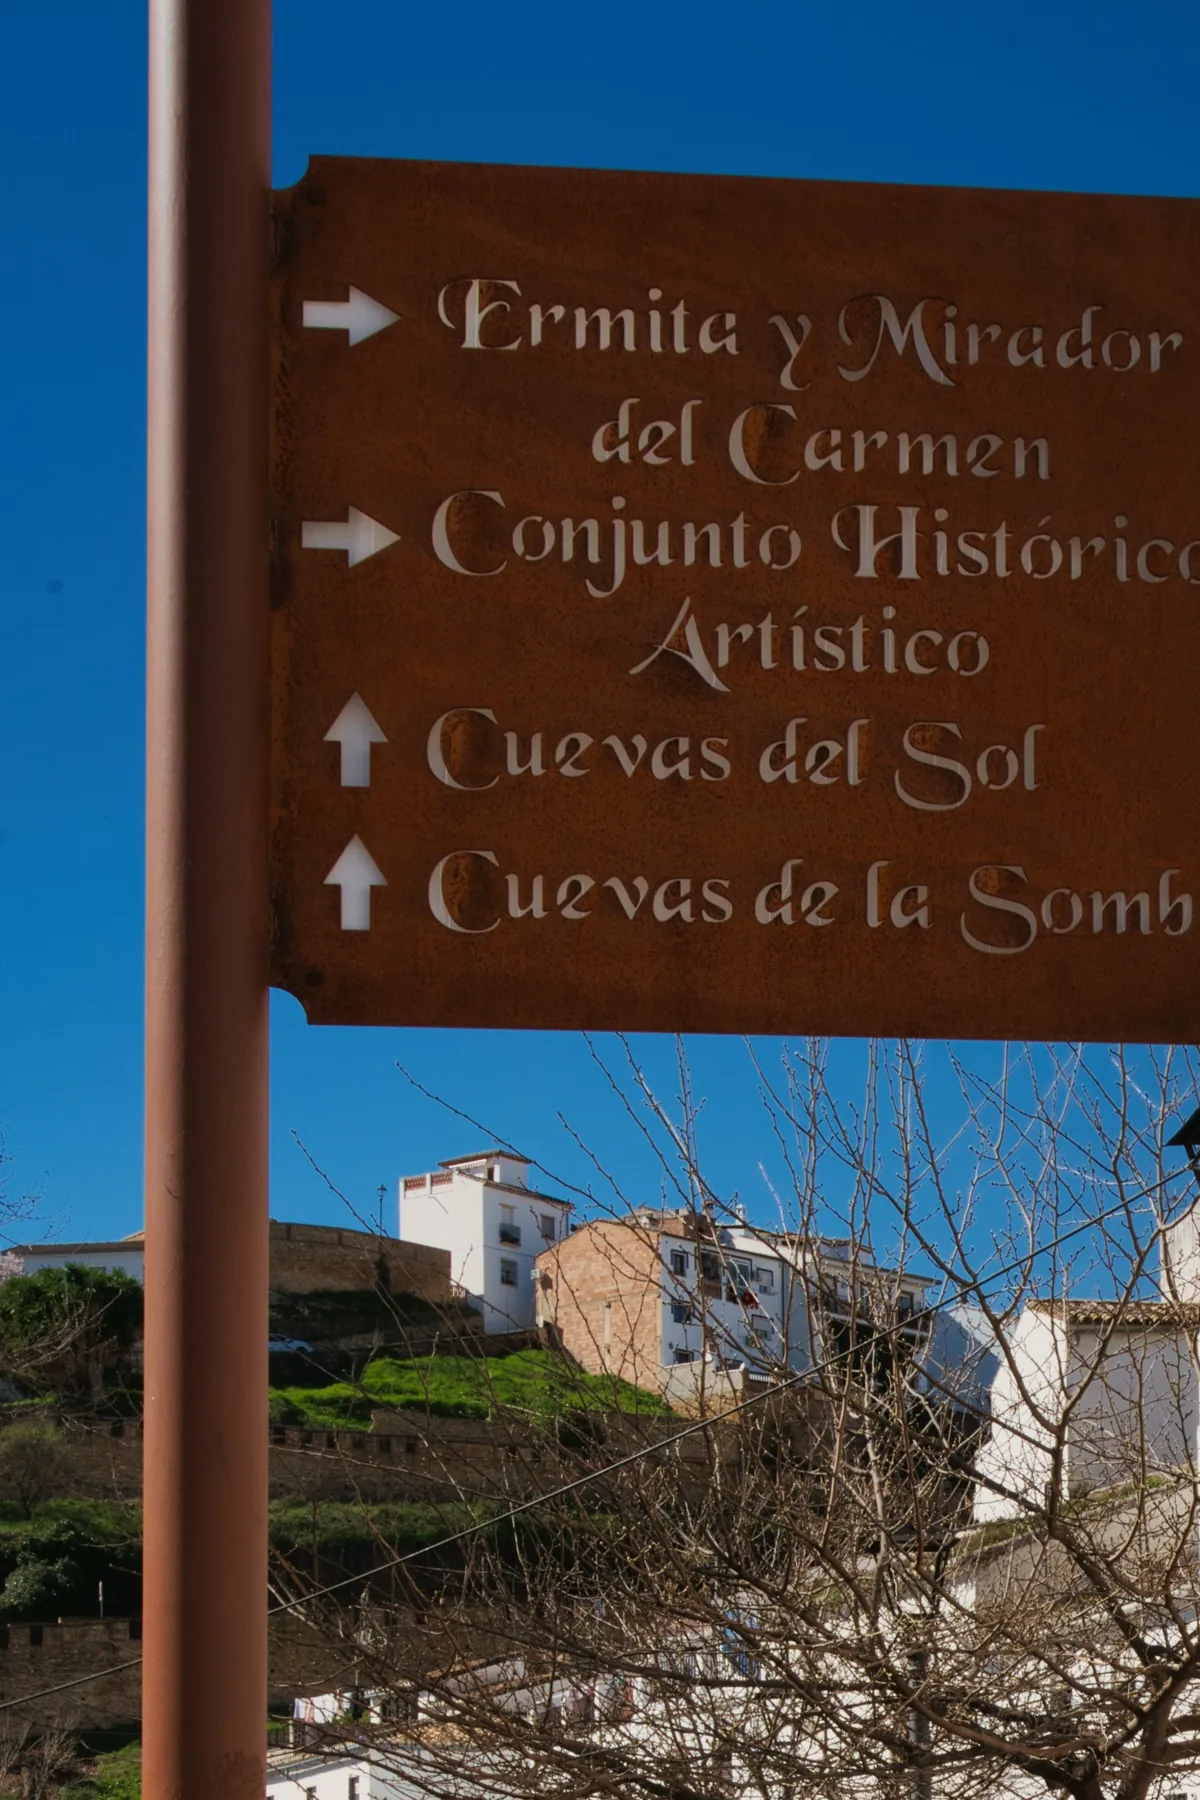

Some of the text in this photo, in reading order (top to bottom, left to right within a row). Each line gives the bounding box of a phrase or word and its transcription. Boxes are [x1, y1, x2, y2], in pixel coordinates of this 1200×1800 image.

[437, 278, 1184, 391] Ermita y Mirador
[591, 399, 1052, 485] del Carmen
[431, 490, 802, 598] Conjunto
[629, 597, 991, 692] Artístico
[427, 708, 1046, 811] Cuevas del Sol
[428, 850, 733, 933] Cuevas
[754, 859, 839, 927] de
[867, 861, 933, 929] la
